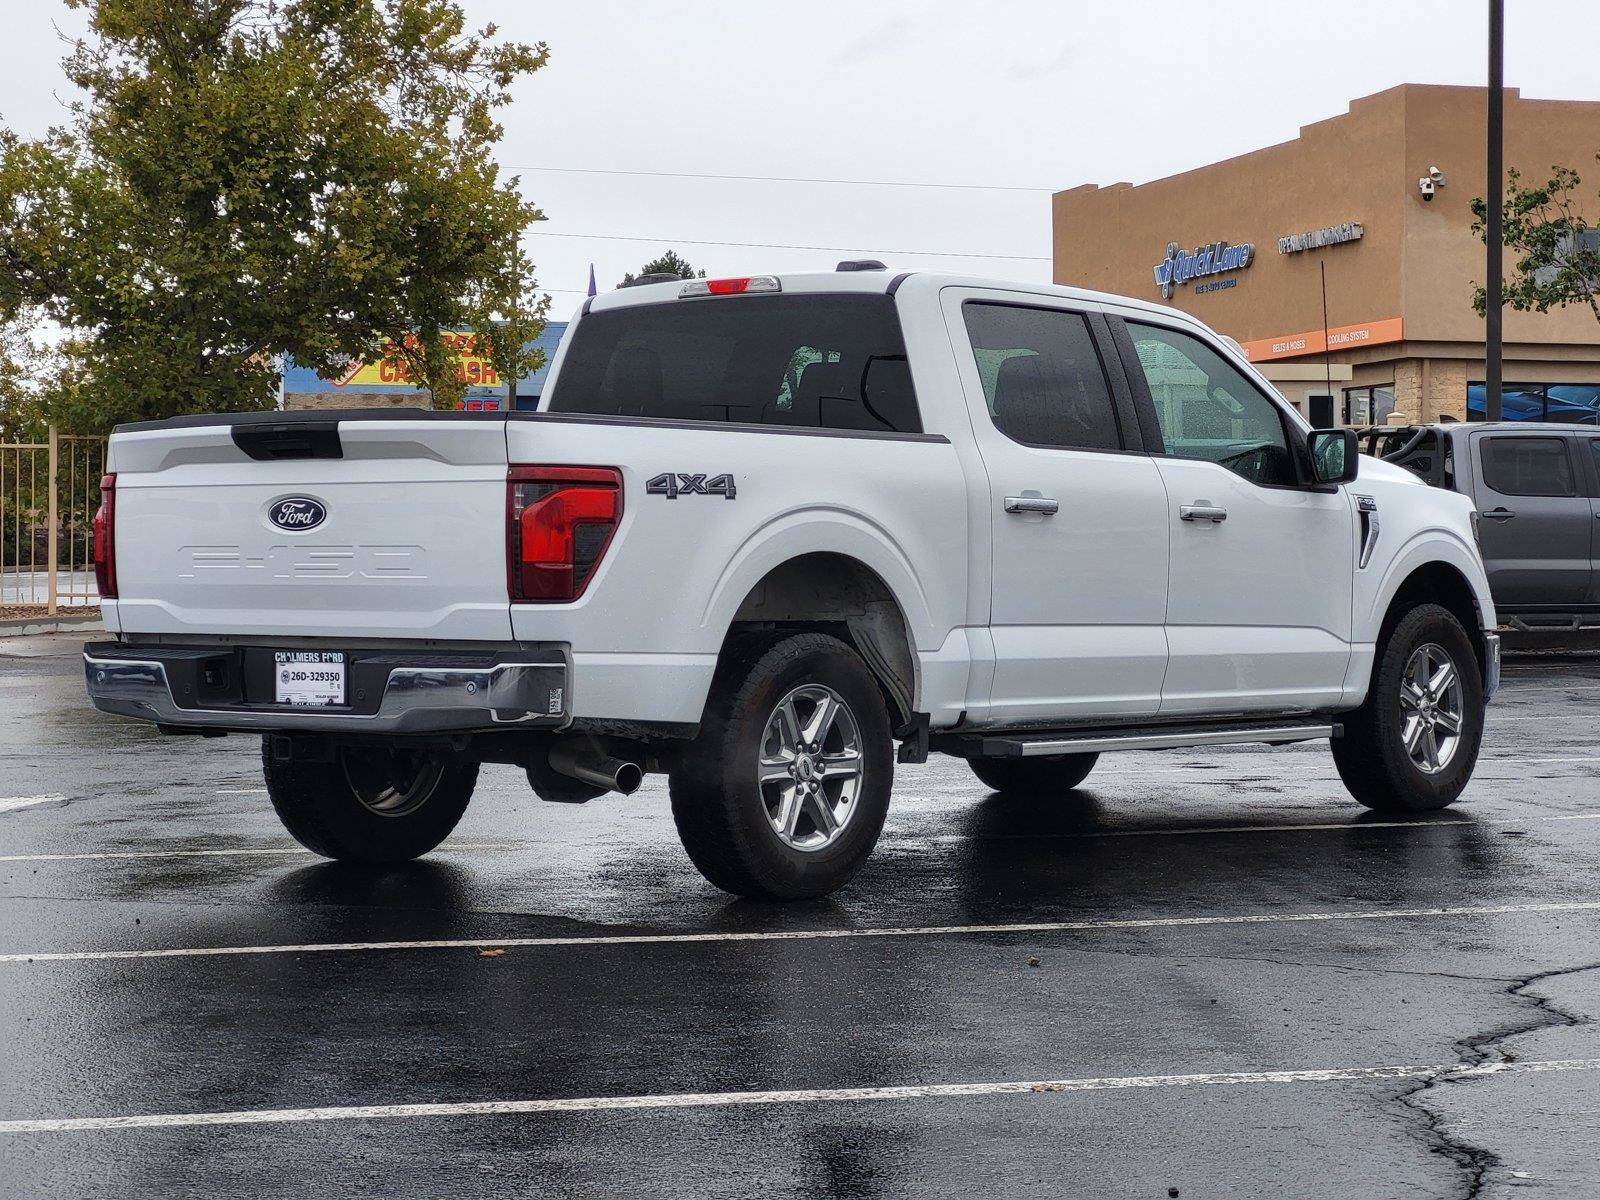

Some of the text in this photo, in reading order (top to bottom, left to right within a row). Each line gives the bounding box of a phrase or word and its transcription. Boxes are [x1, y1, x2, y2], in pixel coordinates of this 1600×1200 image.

[1173, 241, 1251, 284] Quick Lane
[1328, 329, 1369, 344] COOLING SYSTEM
[1273, 343, 1286, 353] BELTS
[1290, 339, 1306, 350] HOSES
[278, 502, 314, 524] Ford
[275, 652, 320, 662] CHALMERS
[291, 671, 340, 682] 26D-329350
